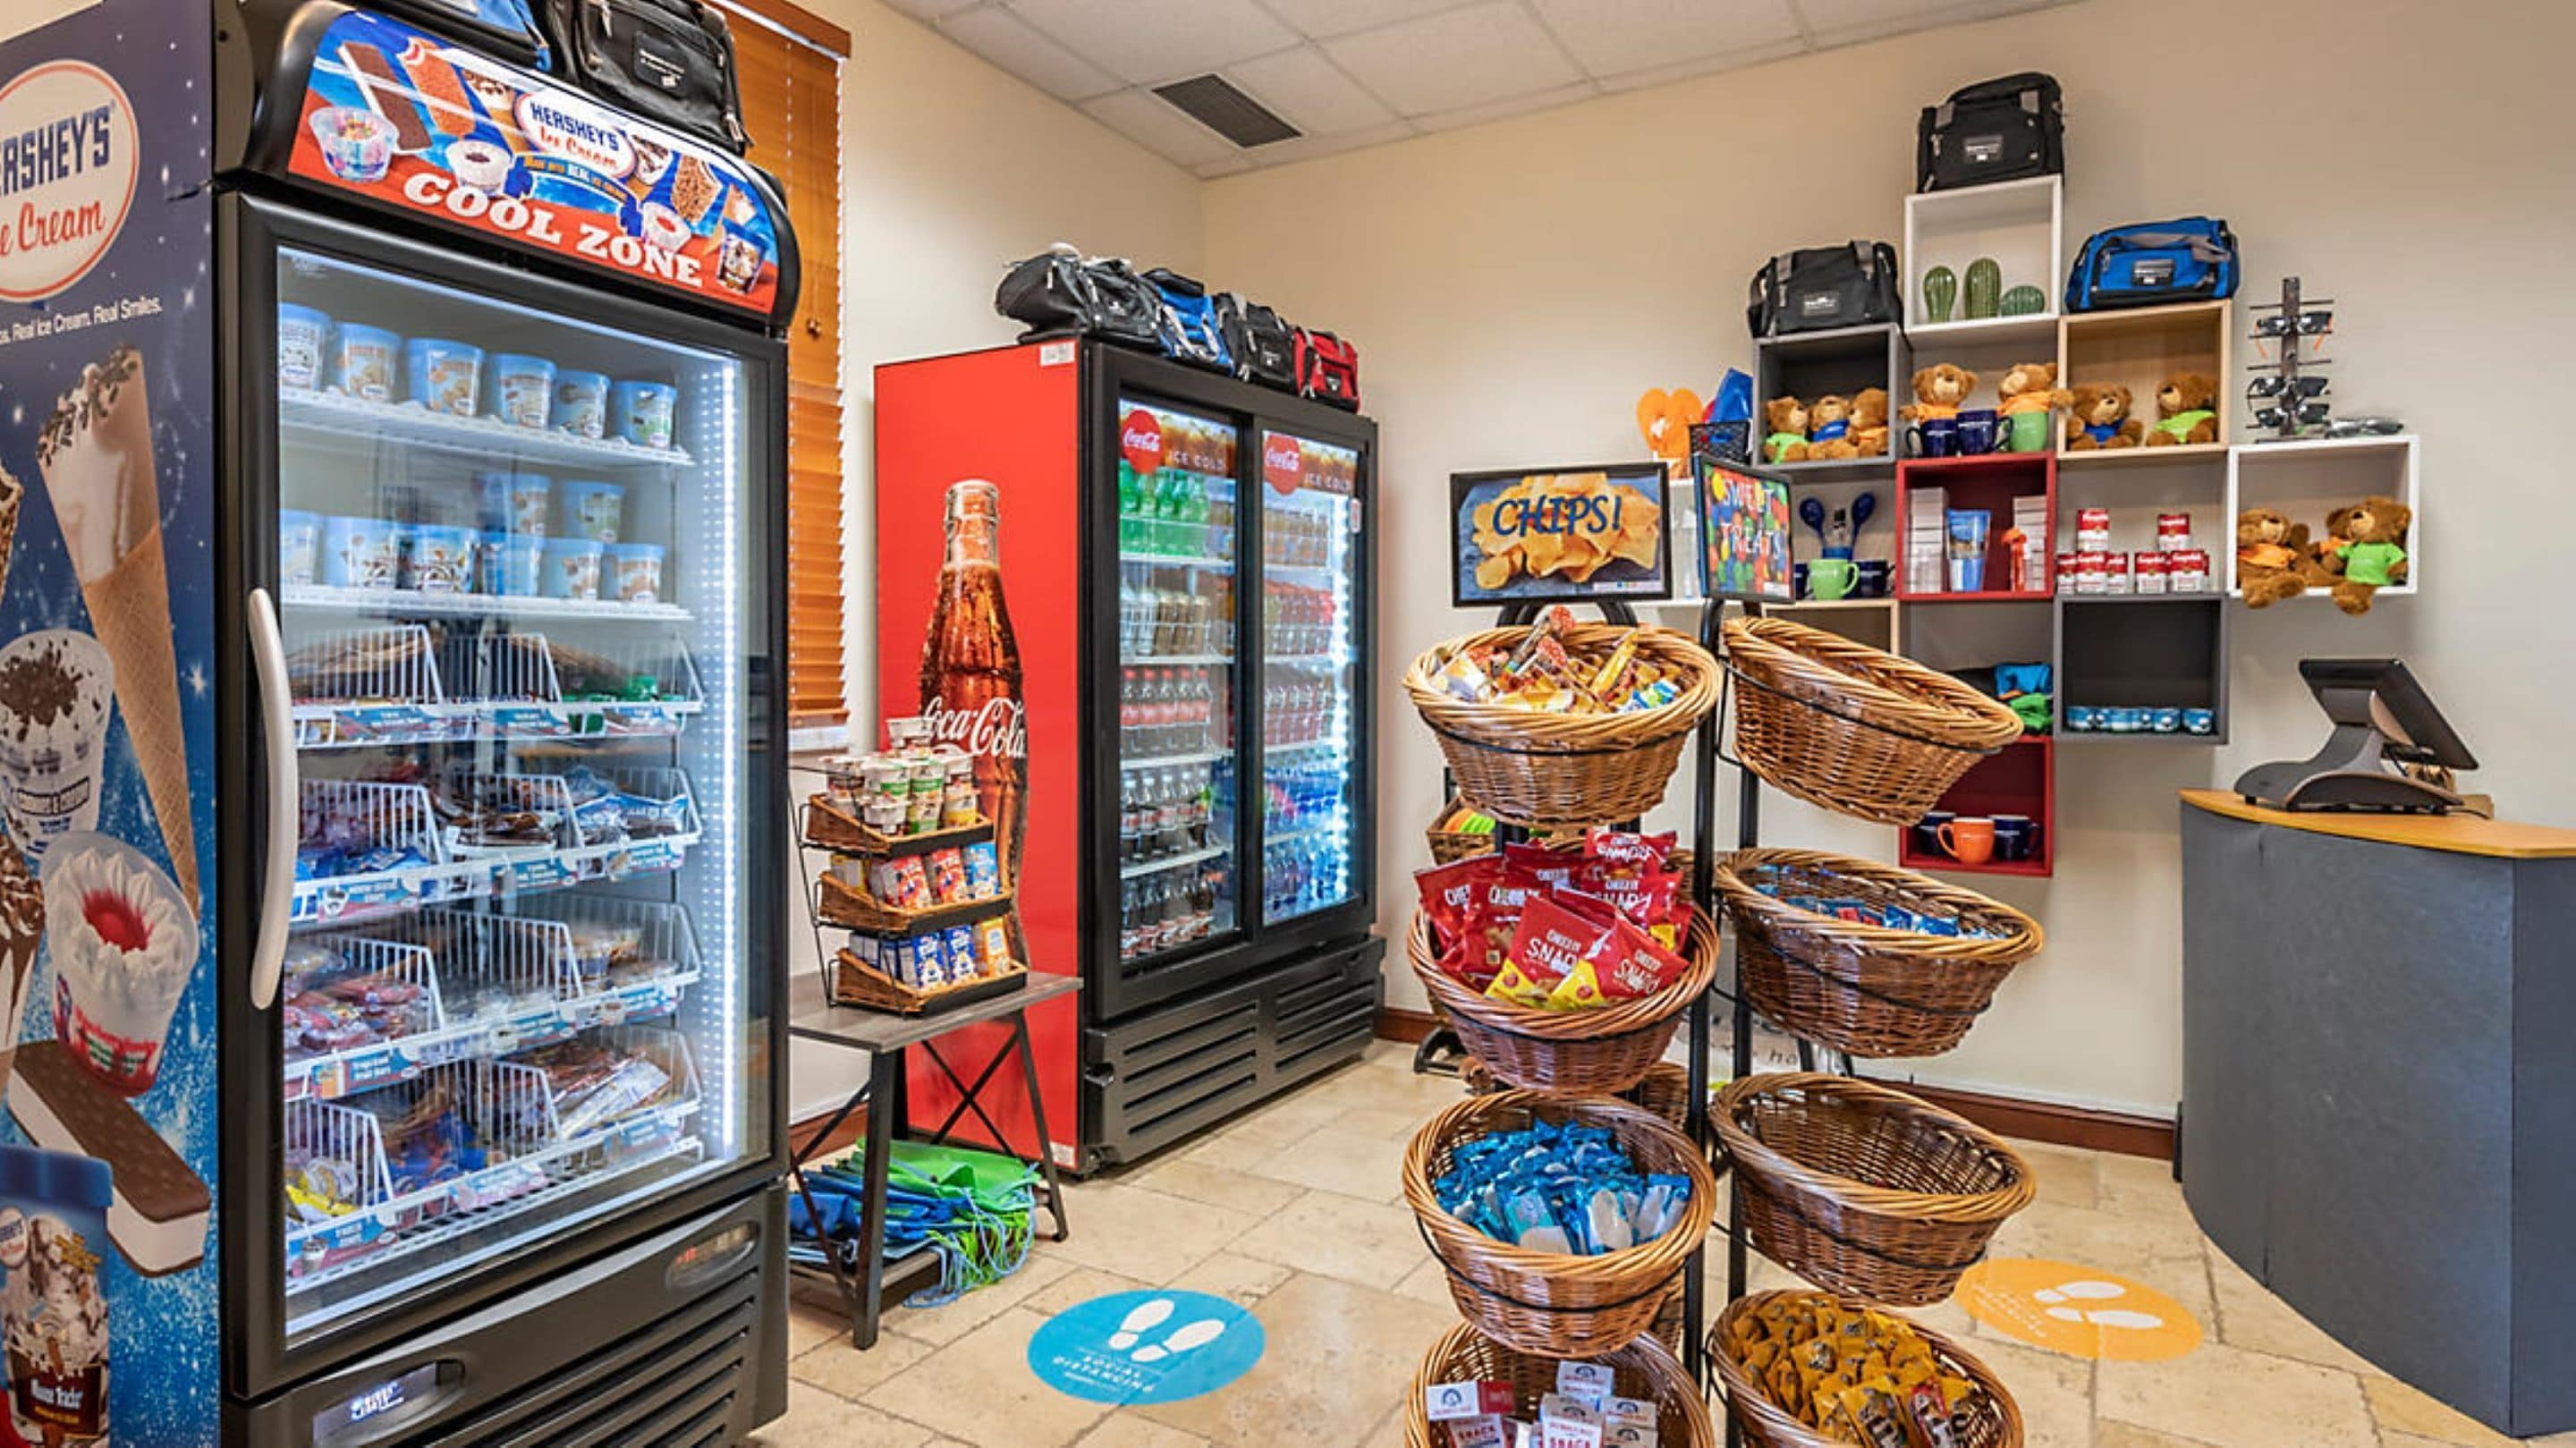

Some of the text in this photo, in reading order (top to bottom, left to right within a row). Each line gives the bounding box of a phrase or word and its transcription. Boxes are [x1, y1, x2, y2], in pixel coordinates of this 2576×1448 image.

[530, 101, 619, 151] HERSHEY'S
[0, 105, 114, 195] RSHEY'S
[18, 199, 106, 252] Cream
[403, 172, 704, 287] COOL ZONE
[94, 301, 118, 325] Real
[1492, 494, 1622, 538] CHIPS!
[1723, 478, 1775, 515] SWEET
[1720, 522, 1785, 561] TREATS
[1053, 1355, 1155, 1393] DISTANCING
[1083, 1356, 1141, 1378] SOCIAL
